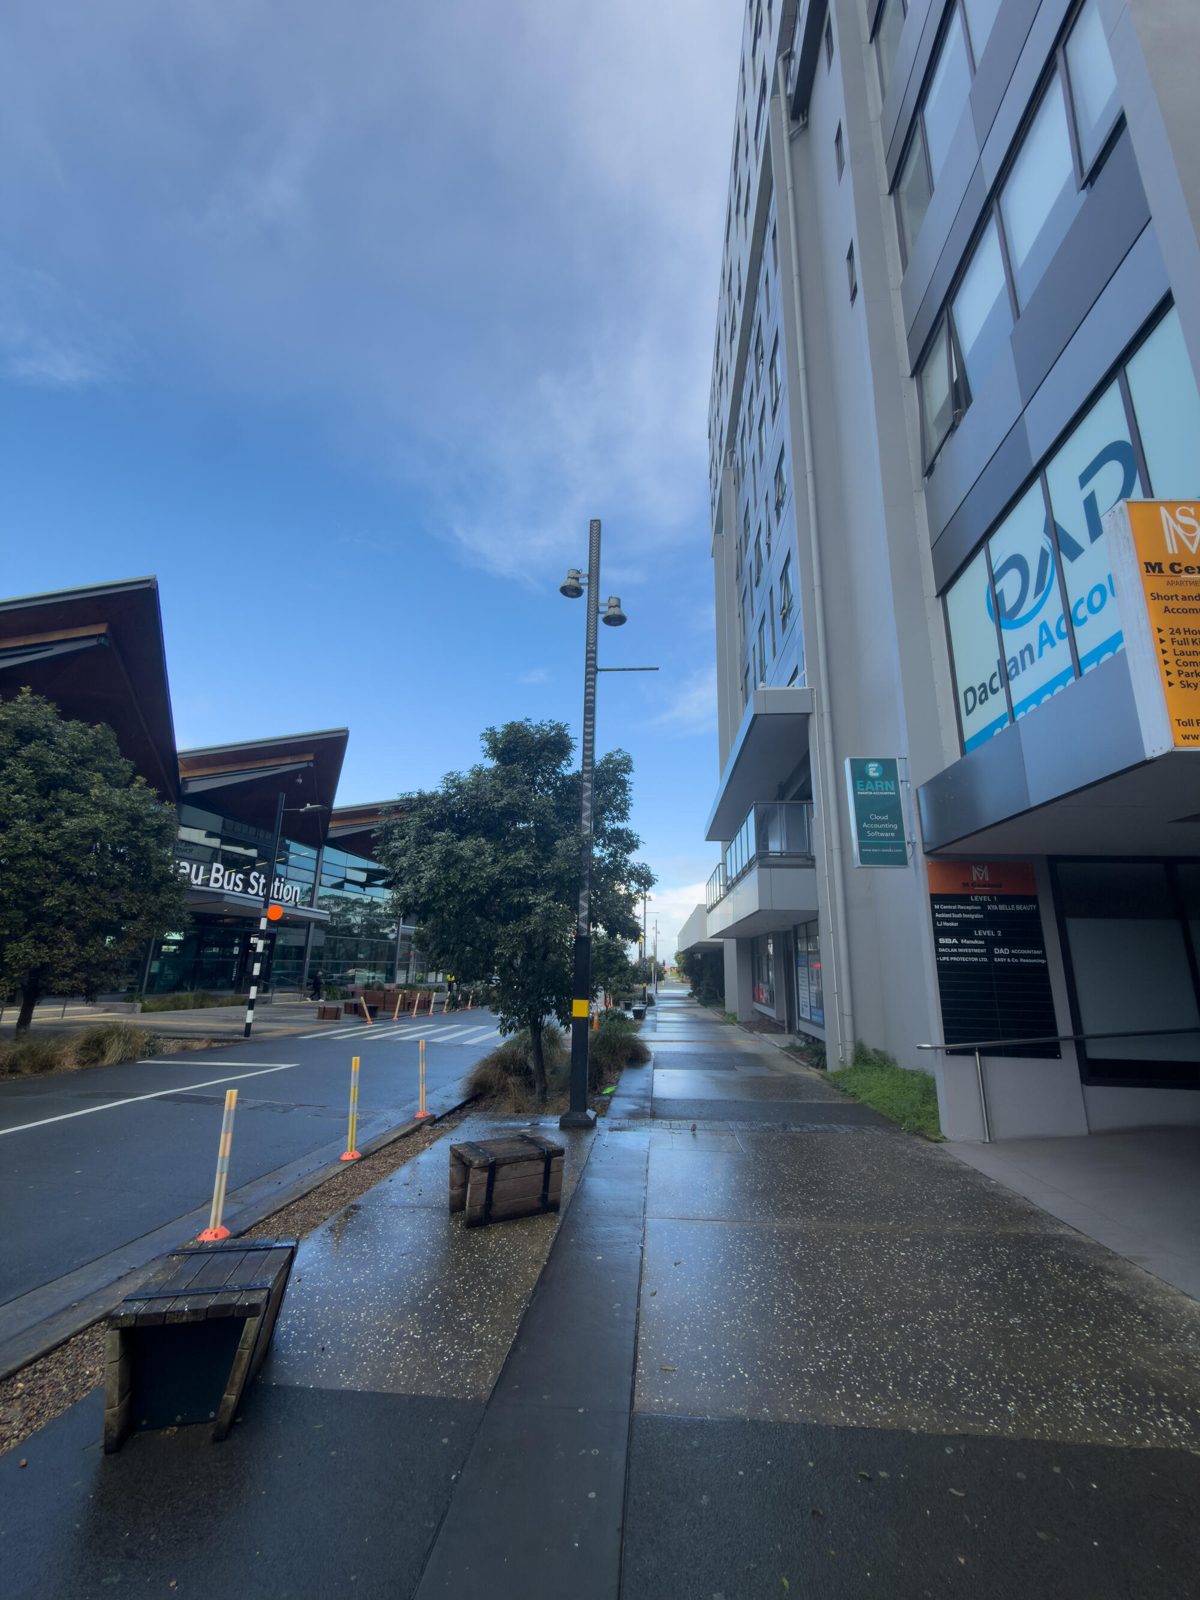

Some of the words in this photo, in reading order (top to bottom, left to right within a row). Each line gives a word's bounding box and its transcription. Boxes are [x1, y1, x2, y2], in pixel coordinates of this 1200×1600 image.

[993, 440, 1138, 621] DAD
[1144, 561, 1164, 574] M
[1150, 592, 1179, 602] Short
[1164, 605, 1200, 615] Accom
[1169, 627, 1181, 636] 24
[1171, 637, 1190, 646] Full
[1173, 648, 1200, 657] Laun
[1175, 659, 1200, 667] Com
[963, 642, 1036, 716] Daclan
[1180, 680, 1198, 691] Sky
[1176, 718, 1194, 728] Toll
[1181, 733, 1200, 741] ww
[856, 780, 895, 791] EARN
[862, 822, 898, 830] Accounting
[209, 862, 244, 892] Bus
